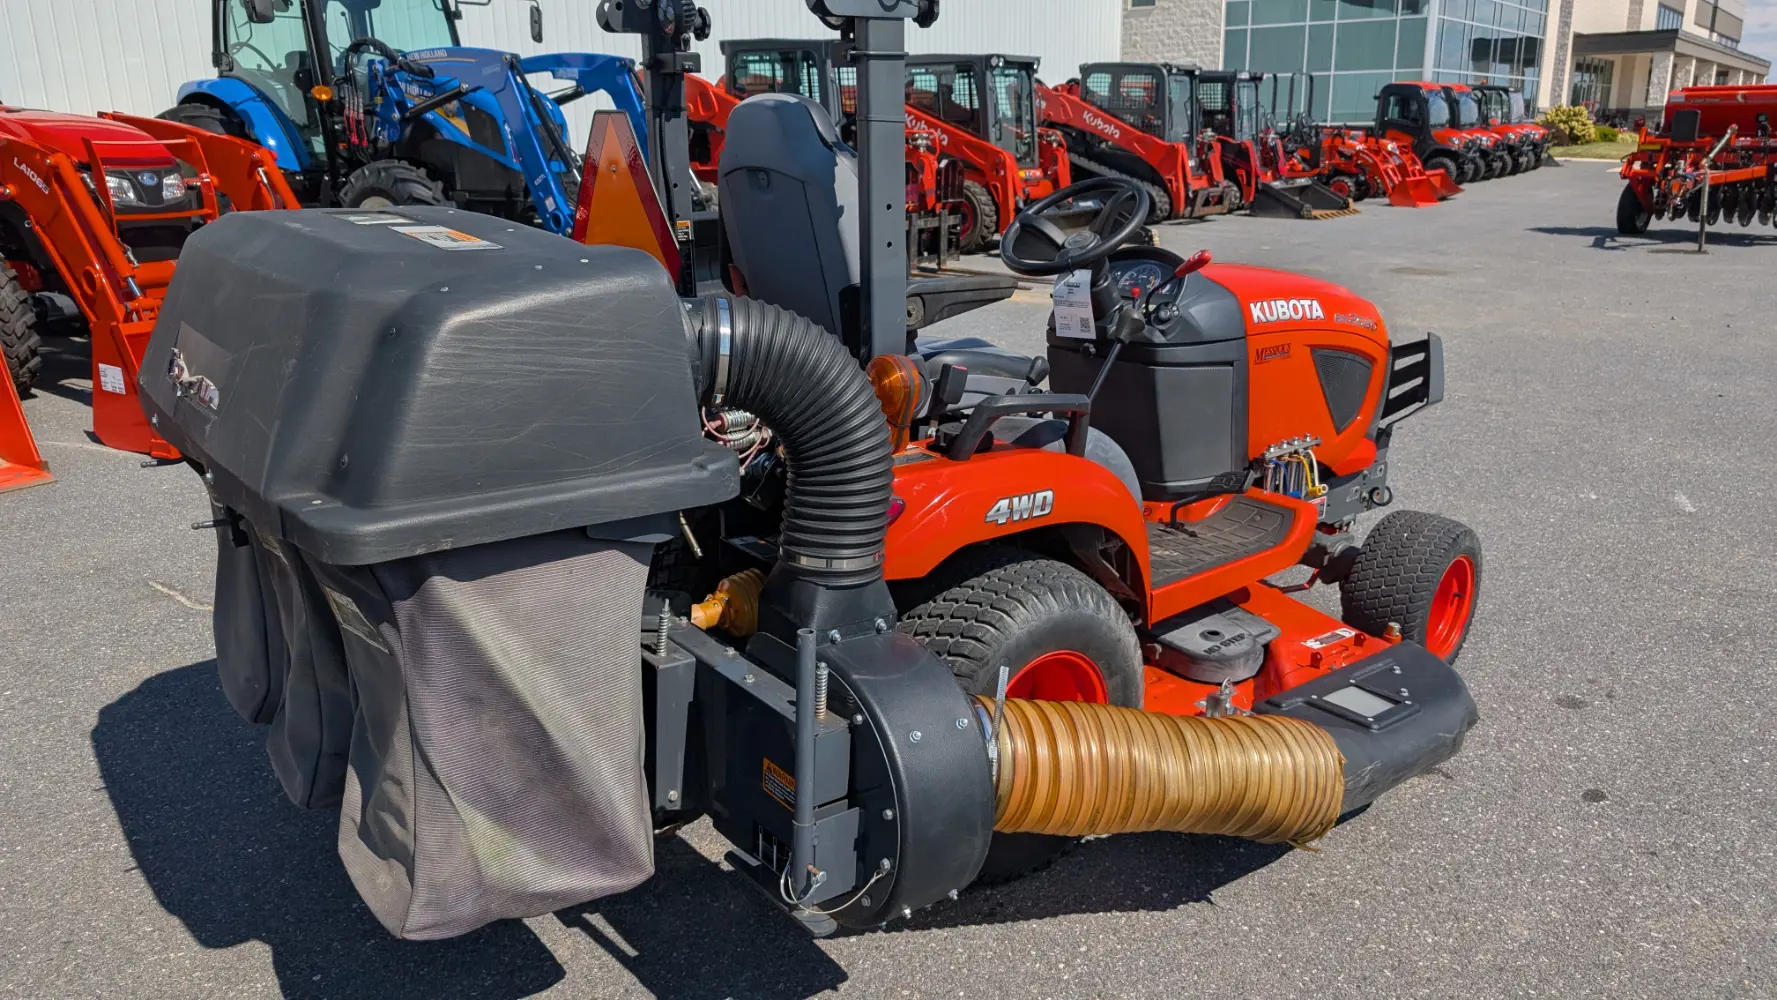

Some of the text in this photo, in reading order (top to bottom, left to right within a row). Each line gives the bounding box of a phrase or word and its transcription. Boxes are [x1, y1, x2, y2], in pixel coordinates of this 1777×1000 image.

[420, 49, 448, 60] HOLLAND
[904, 113, 949, 146] Kubta
[1082, 109, 1121, 139] Kubota
[13, 156, 50, 195] LA1065
[1249, 299, 1325, 323] KUBOTA
[984, 488, 1055, 526] 4WD
